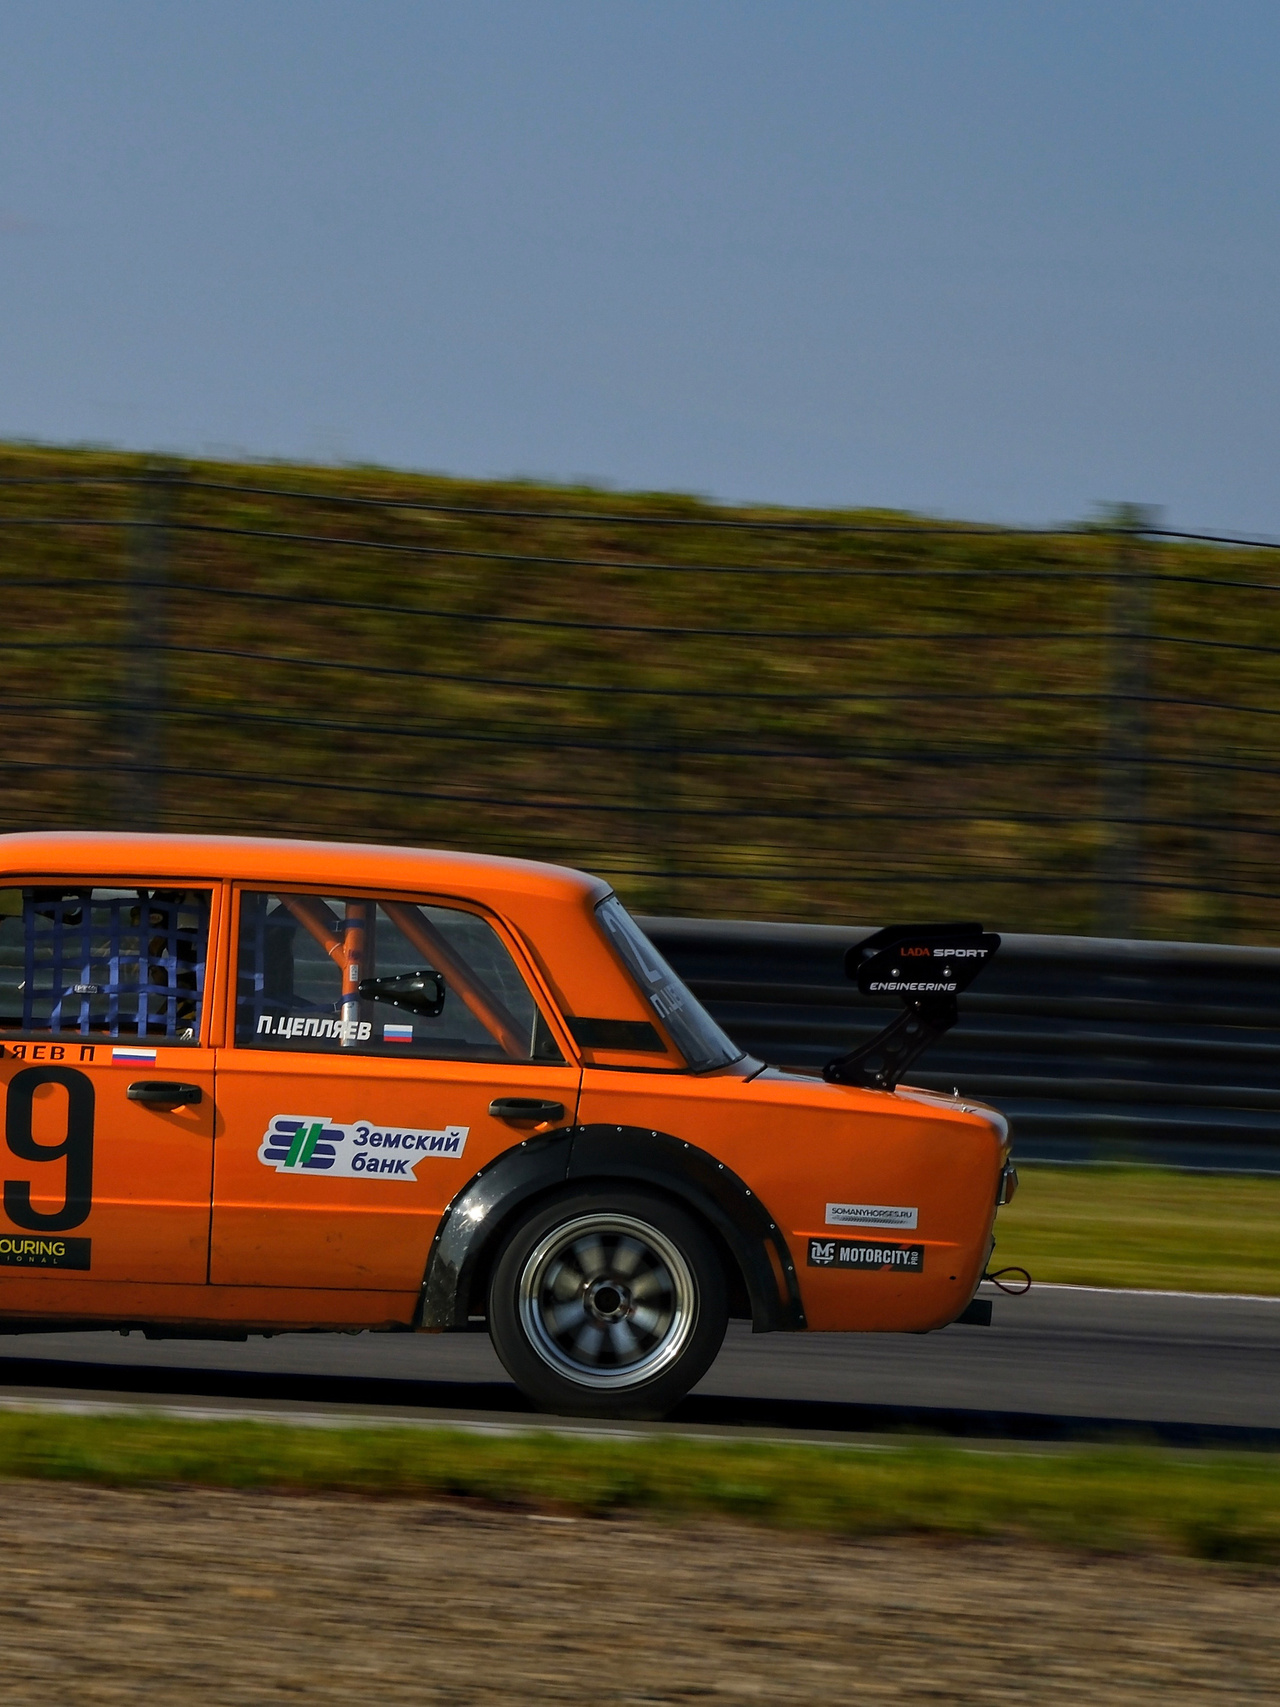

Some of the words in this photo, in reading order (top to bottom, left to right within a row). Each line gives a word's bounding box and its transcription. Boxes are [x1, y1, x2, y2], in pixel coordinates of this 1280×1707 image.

[900, 947, 930, 957] LADA
[933, 949, 988, 958] SPORT
[869, 982, 957, 991] ENGINEERING
[256, 1015, 372, 1041] П.ЦЕПЛЯЕВ
[80, 1045, 95, 1061] П
[352, 1126, 461, 1152] Земский
[351, 1152, 410, 1175] банк
[831, 1207, 912, 1218] SOMANYHORSES.RU
